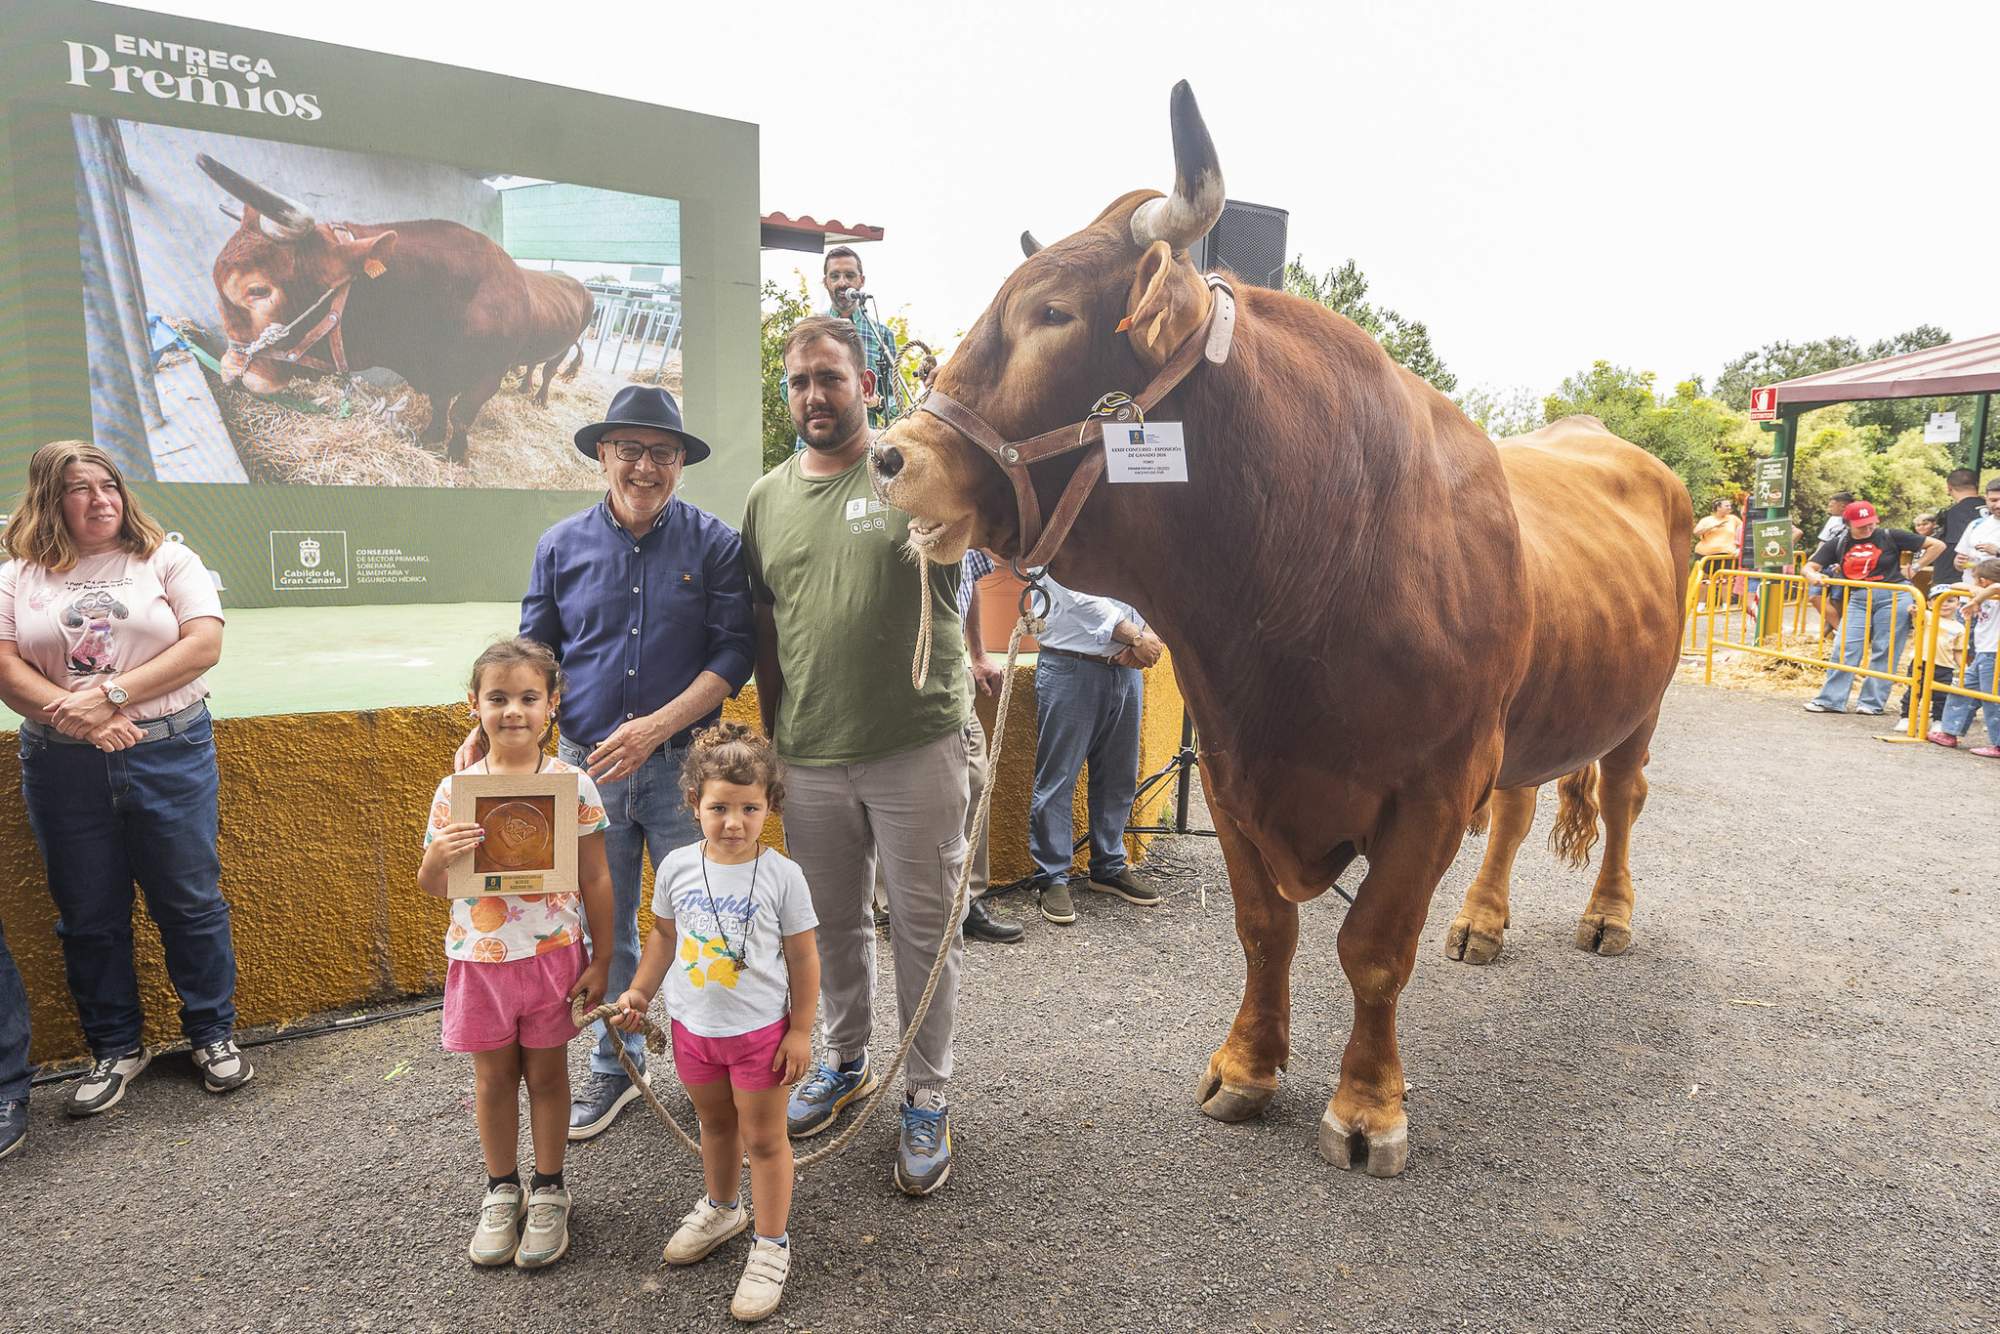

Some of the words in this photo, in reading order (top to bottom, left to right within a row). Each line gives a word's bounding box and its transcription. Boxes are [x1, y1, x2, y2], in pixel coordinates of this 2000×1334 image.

[115, 34, 277, 78] ENTREGA
[63, 40, 322, 121] Premios
[186, 65, 209, 77] DE
[284, 569, 321, 577] Cabildo
[322, 569, 335, 577] de
[305, 576, 342, 584] Canaria
[679, 888, 760, 923] Freshly
